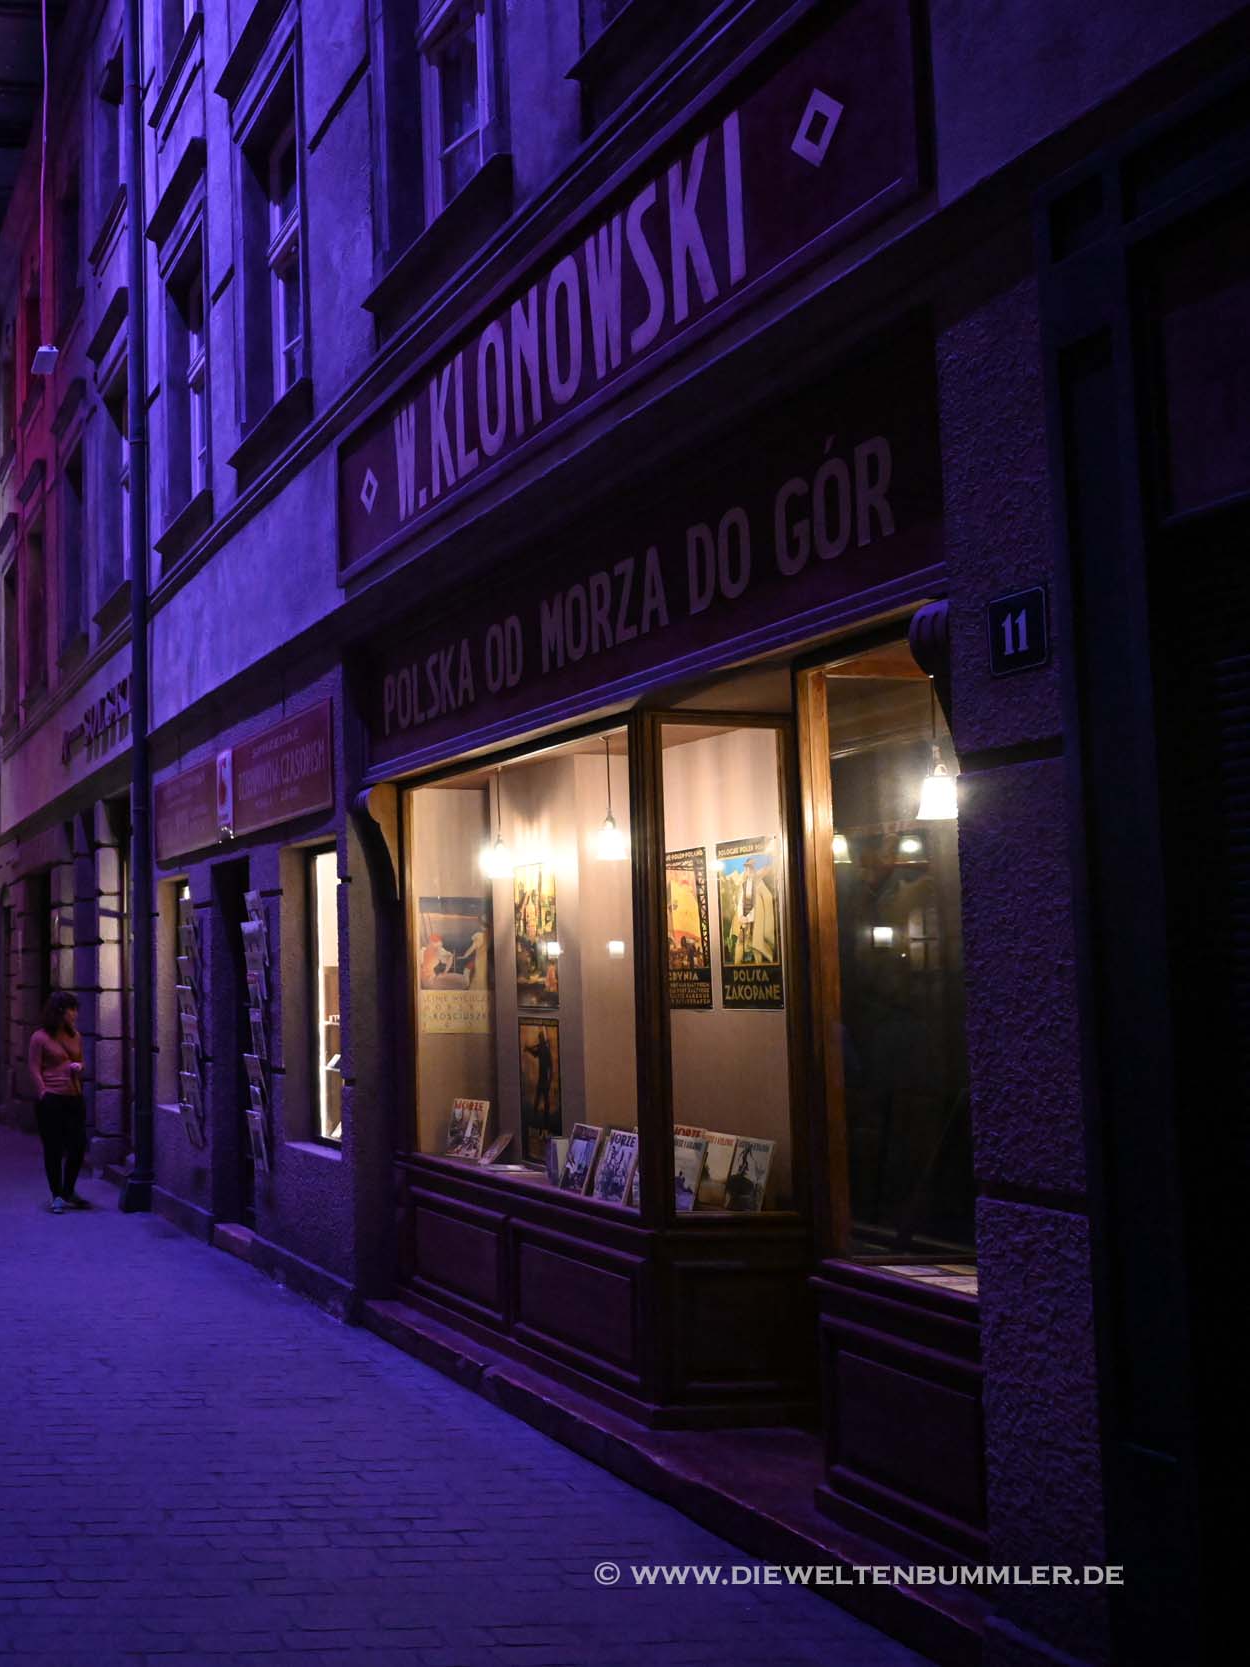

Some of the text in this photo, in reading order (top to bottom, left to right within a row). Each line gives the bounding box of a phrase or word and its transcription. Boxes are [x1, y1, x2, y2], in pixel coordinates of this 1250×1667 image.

[382, 433, 896, 737] POLSKA OD MORZA DO GÓR
[1001, 608, 1030, 656] 11
[733, 969, 769, 983] POLSKA
[724, 985, 782, 1001] ZAKOPANE
